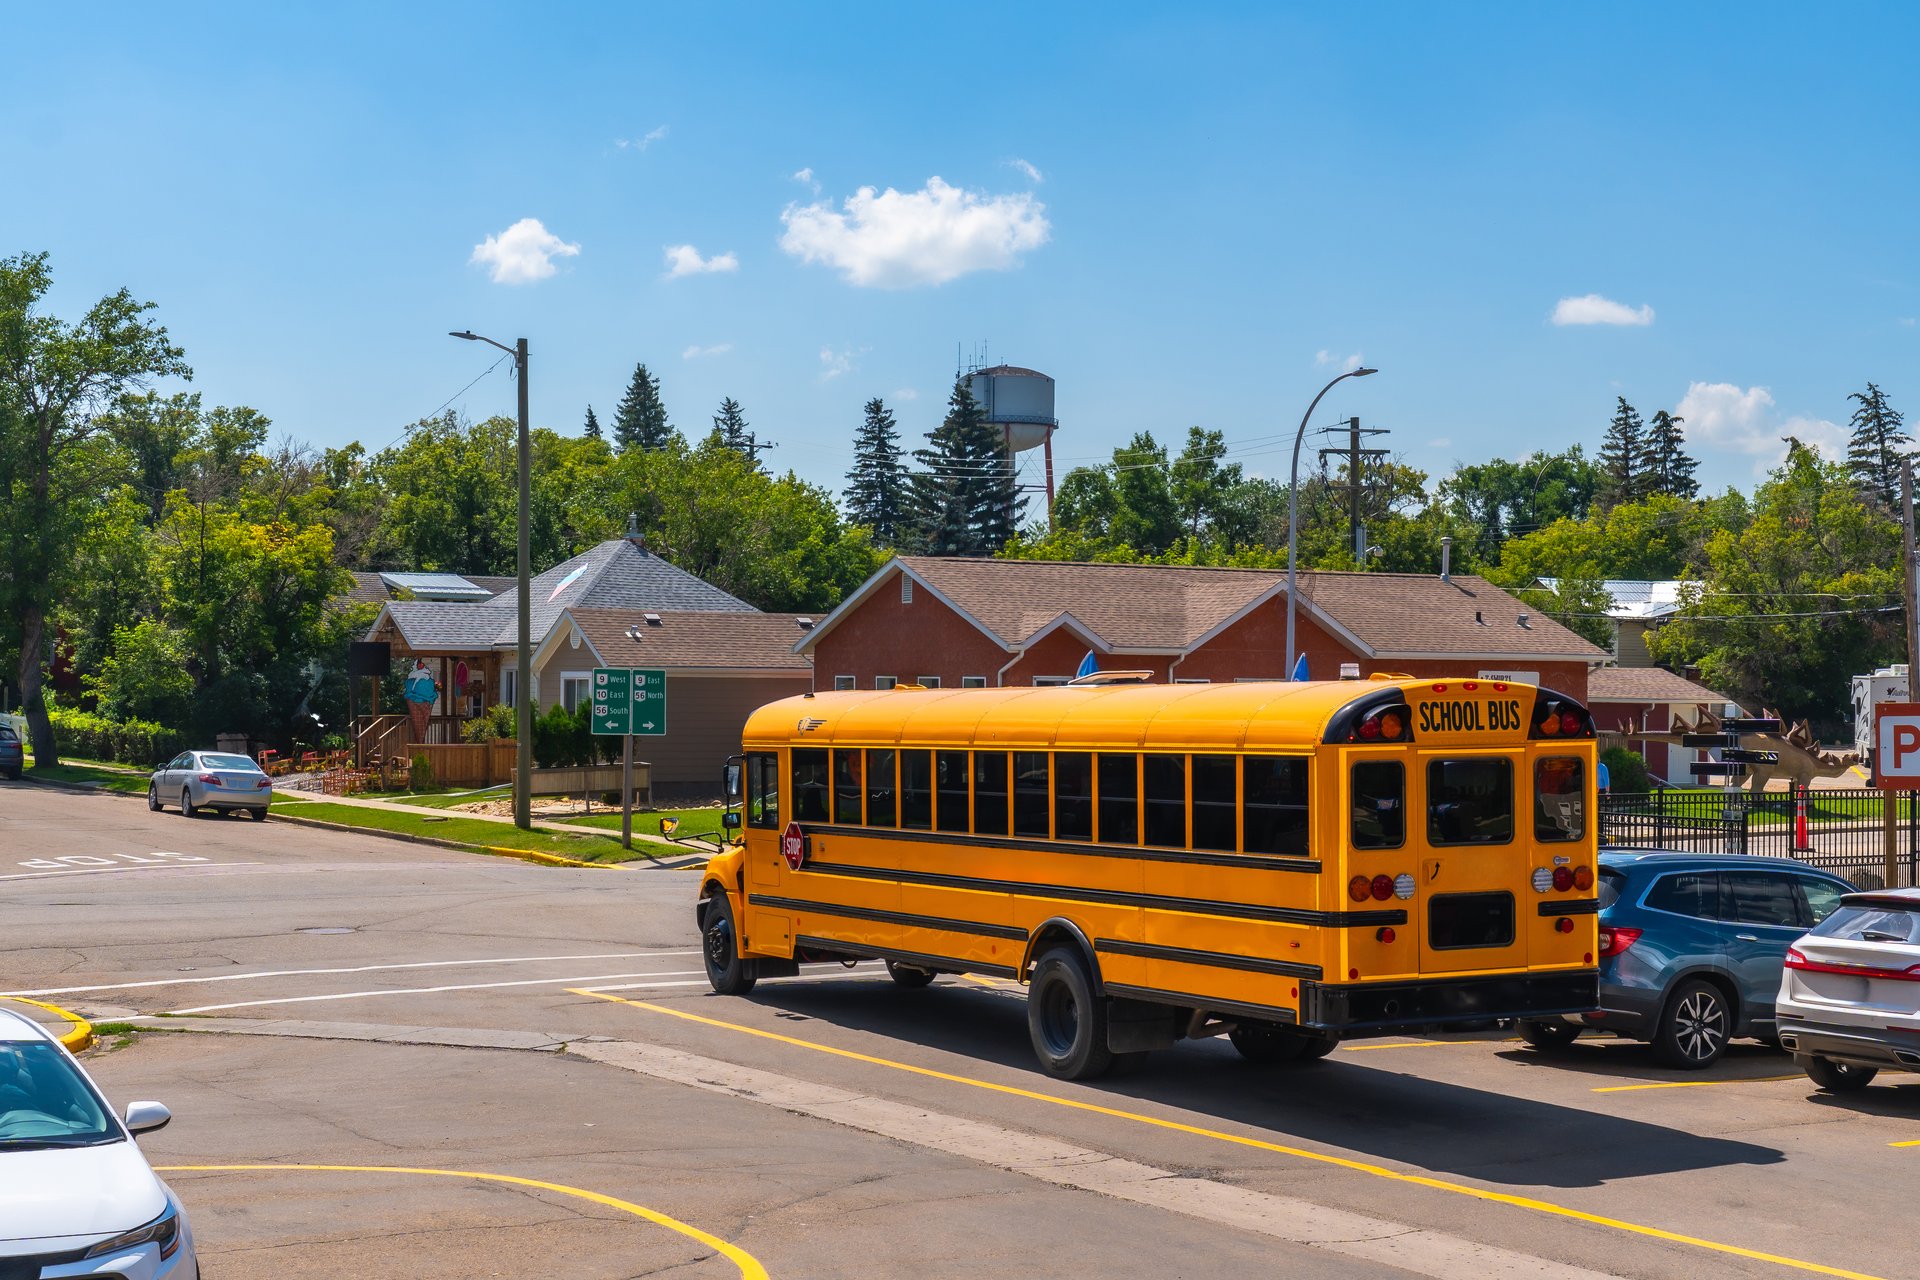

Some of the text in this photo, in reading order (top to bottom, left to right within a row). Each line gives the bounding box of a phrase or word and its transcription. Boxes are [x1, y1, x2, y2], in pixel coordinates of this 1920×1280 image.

[599, 675, 605, 683] 9
[638, 676, 643, 684] 9
[597, 690, 624, 699] 10 East
[596, 706, 629, 715] 56 South
[1419, 700, 1521, 732] SCHOOL BUS
[1893, 724, 1920, 769] P
[786, 837, 801, 856] STOP
[17, 852, 210, 869] STOP
